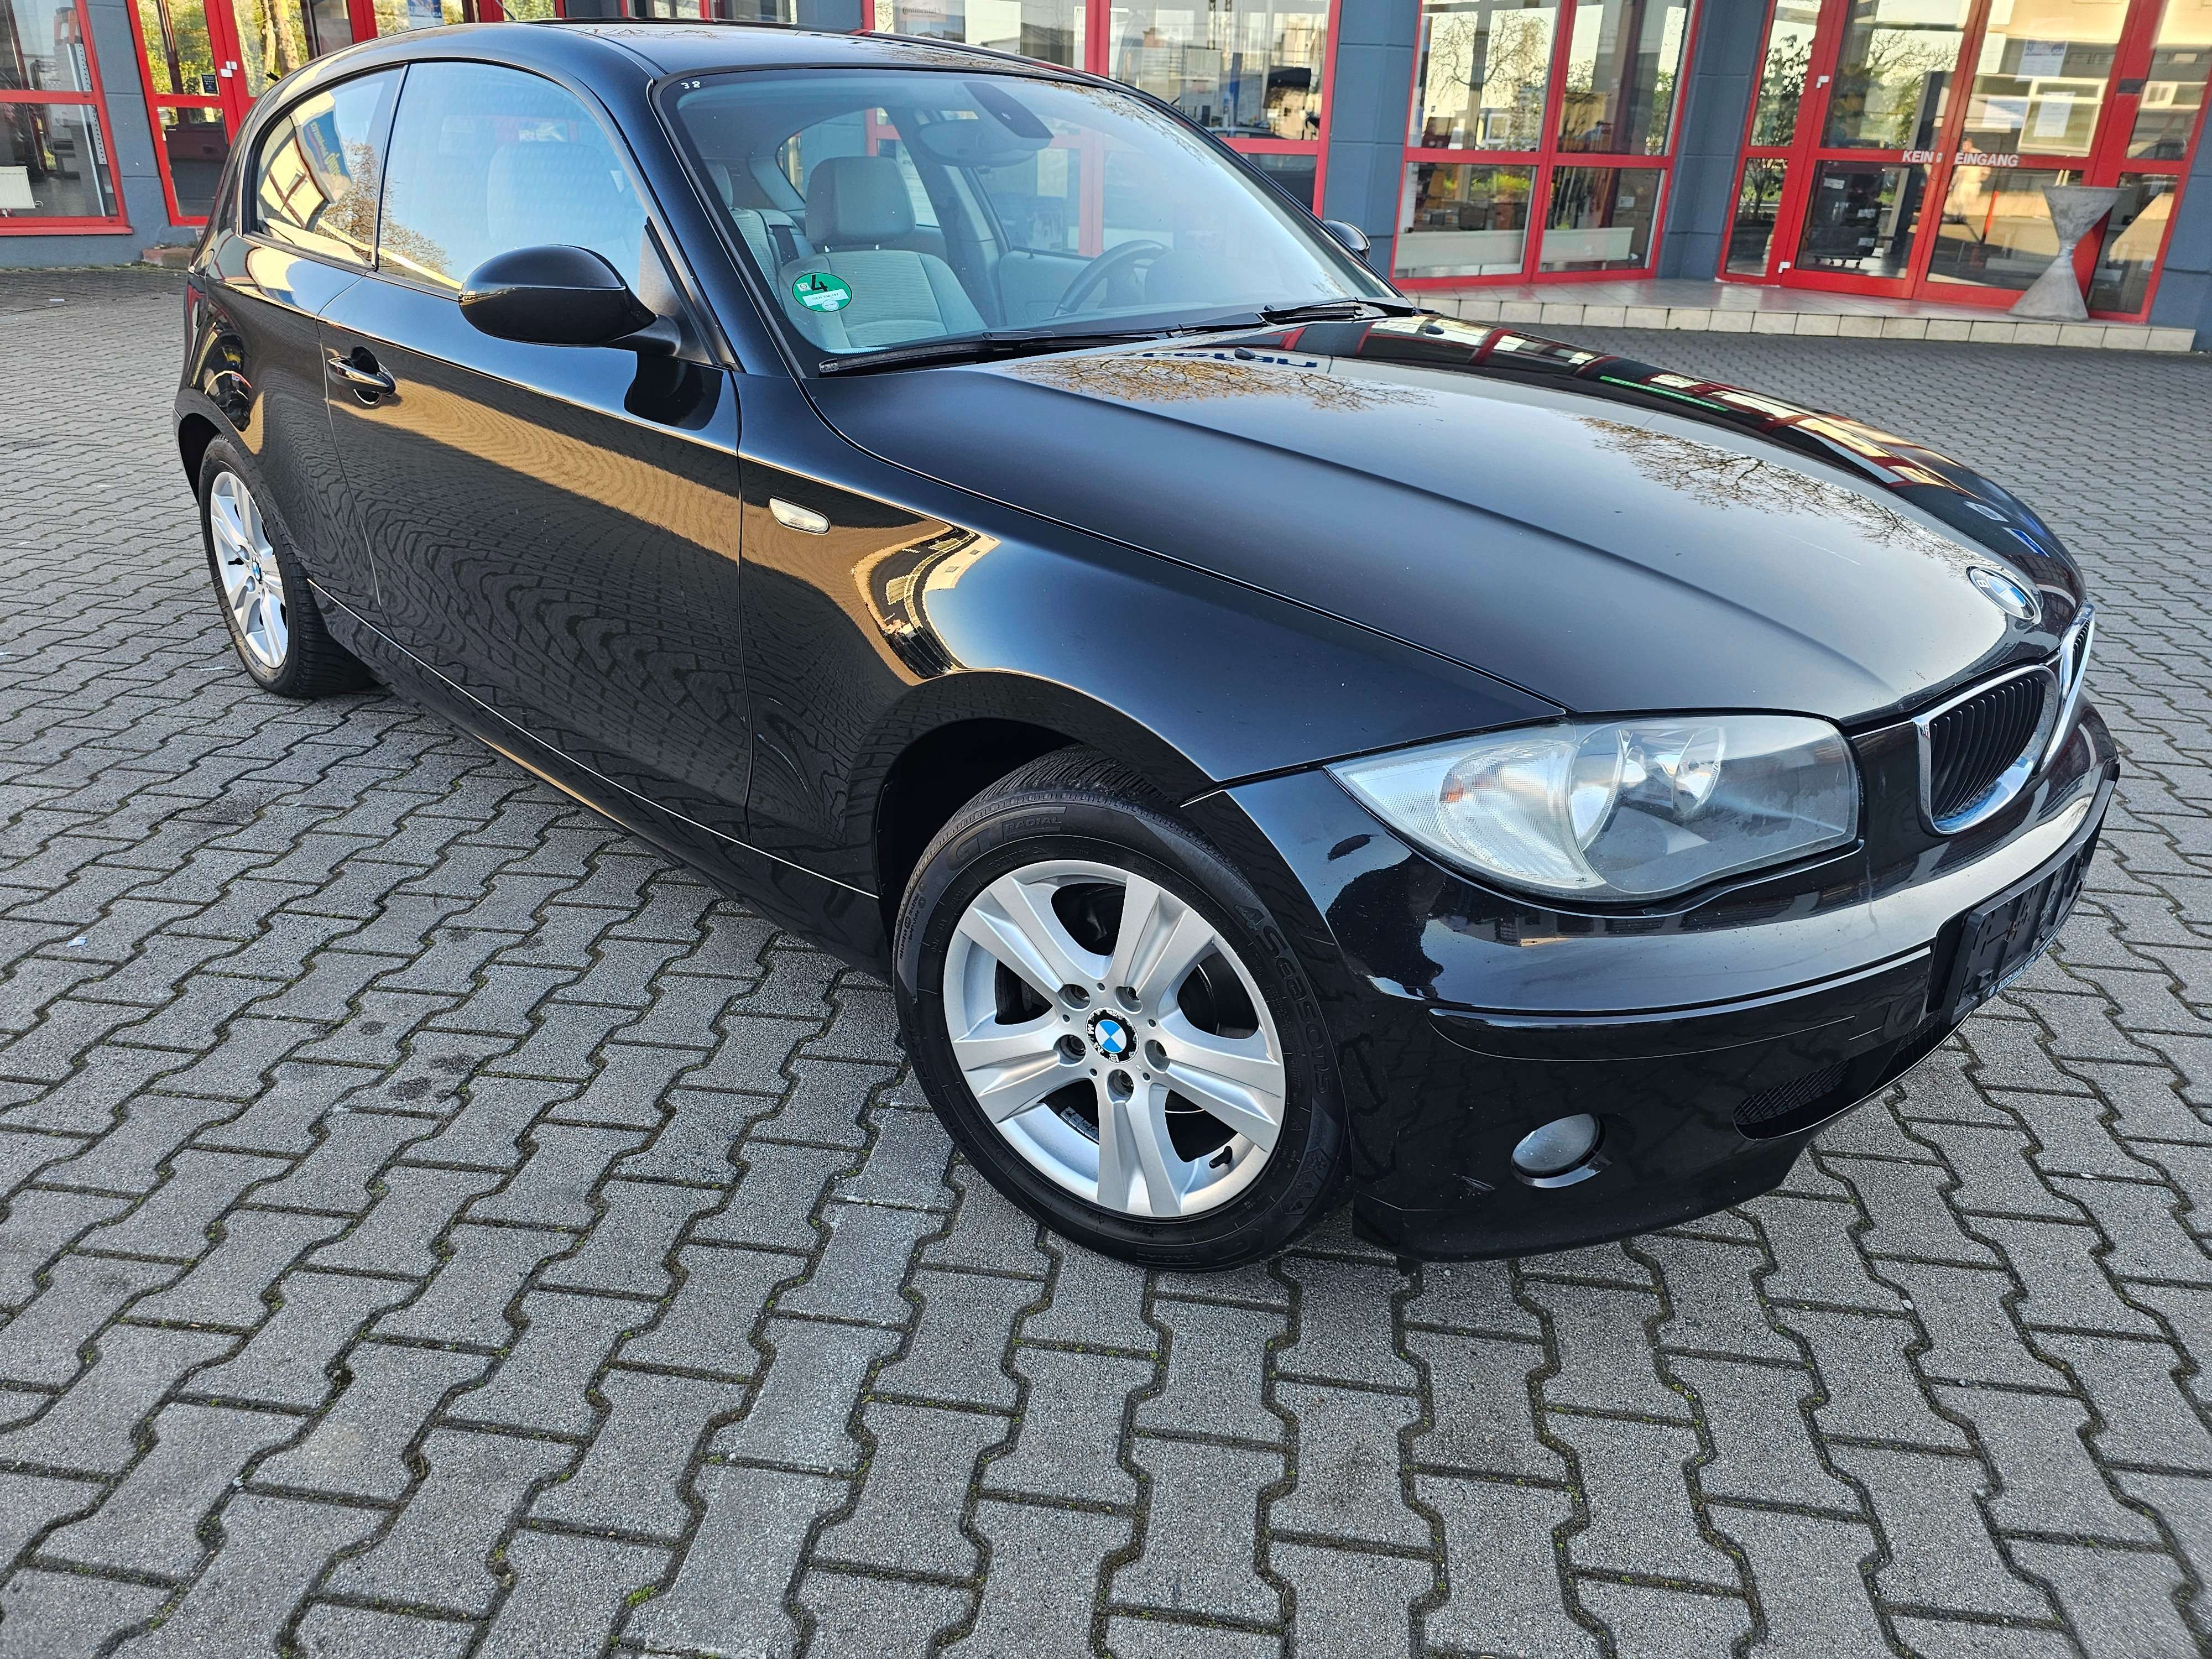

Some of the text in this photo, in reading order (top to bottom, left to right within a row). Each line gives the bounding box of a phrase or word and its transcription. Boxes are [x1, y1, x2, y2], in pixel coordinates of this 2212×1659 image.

[681, 81, 701, 89] 38
[1954, 152, 2018, 167] EINGANG
[812, 275, 828, 291] 4
[1004, 816, 1063, 831] RADIAL
